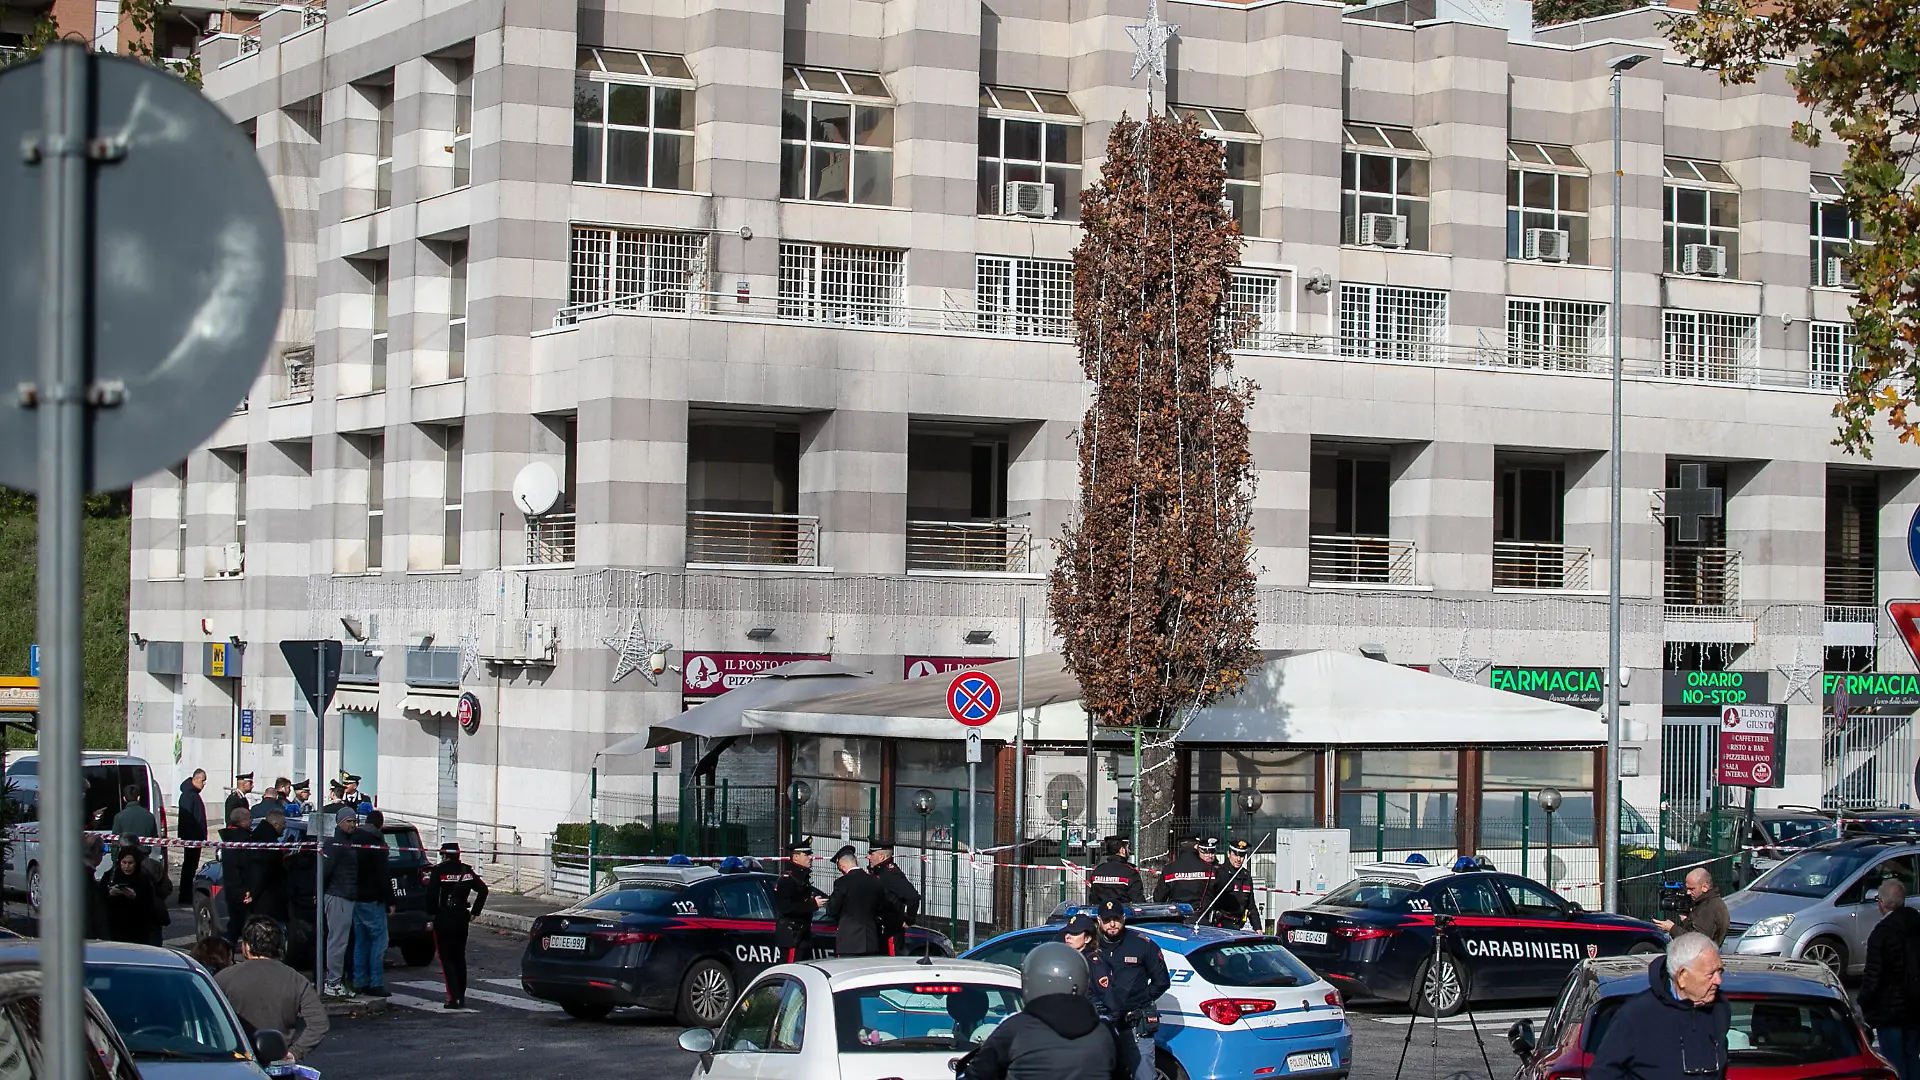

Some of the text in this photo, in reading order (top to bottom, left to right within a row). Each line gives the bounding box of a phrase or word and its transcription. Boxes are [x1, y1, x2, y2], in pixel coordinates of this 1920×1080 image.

[725, 659, 736, 670] IL
[738, 660, 779, 670] POSTO
[1491, 670, 1601, 691] FARMACIA
[1687, 671, 1743, 687] ORARIO
[1682, 689, 1747, 704] NO-STOP
[1741, 709, 1775, 718] IL POSTO
[1746, 720, 1774, 730] GIUSTO
[1735, 734, 1769, 743] CAFFETTERIA
[1730, 743, 1747, 751] RISTO
[1753, 744, 1765, 752] BAR
[1725, 753, 1750, 761] PIZZERIA
[1755, 754, 1770, 762] FOOD
[1725, 770, 1749, 778] INTERNA
[1174, 871, 1206, 879] CARABINIERI
[672, 901, 698, 913] 112
[1407, 899, 1432, 910] 112
[1466, 939, 1580, 960] CARABINIERI
